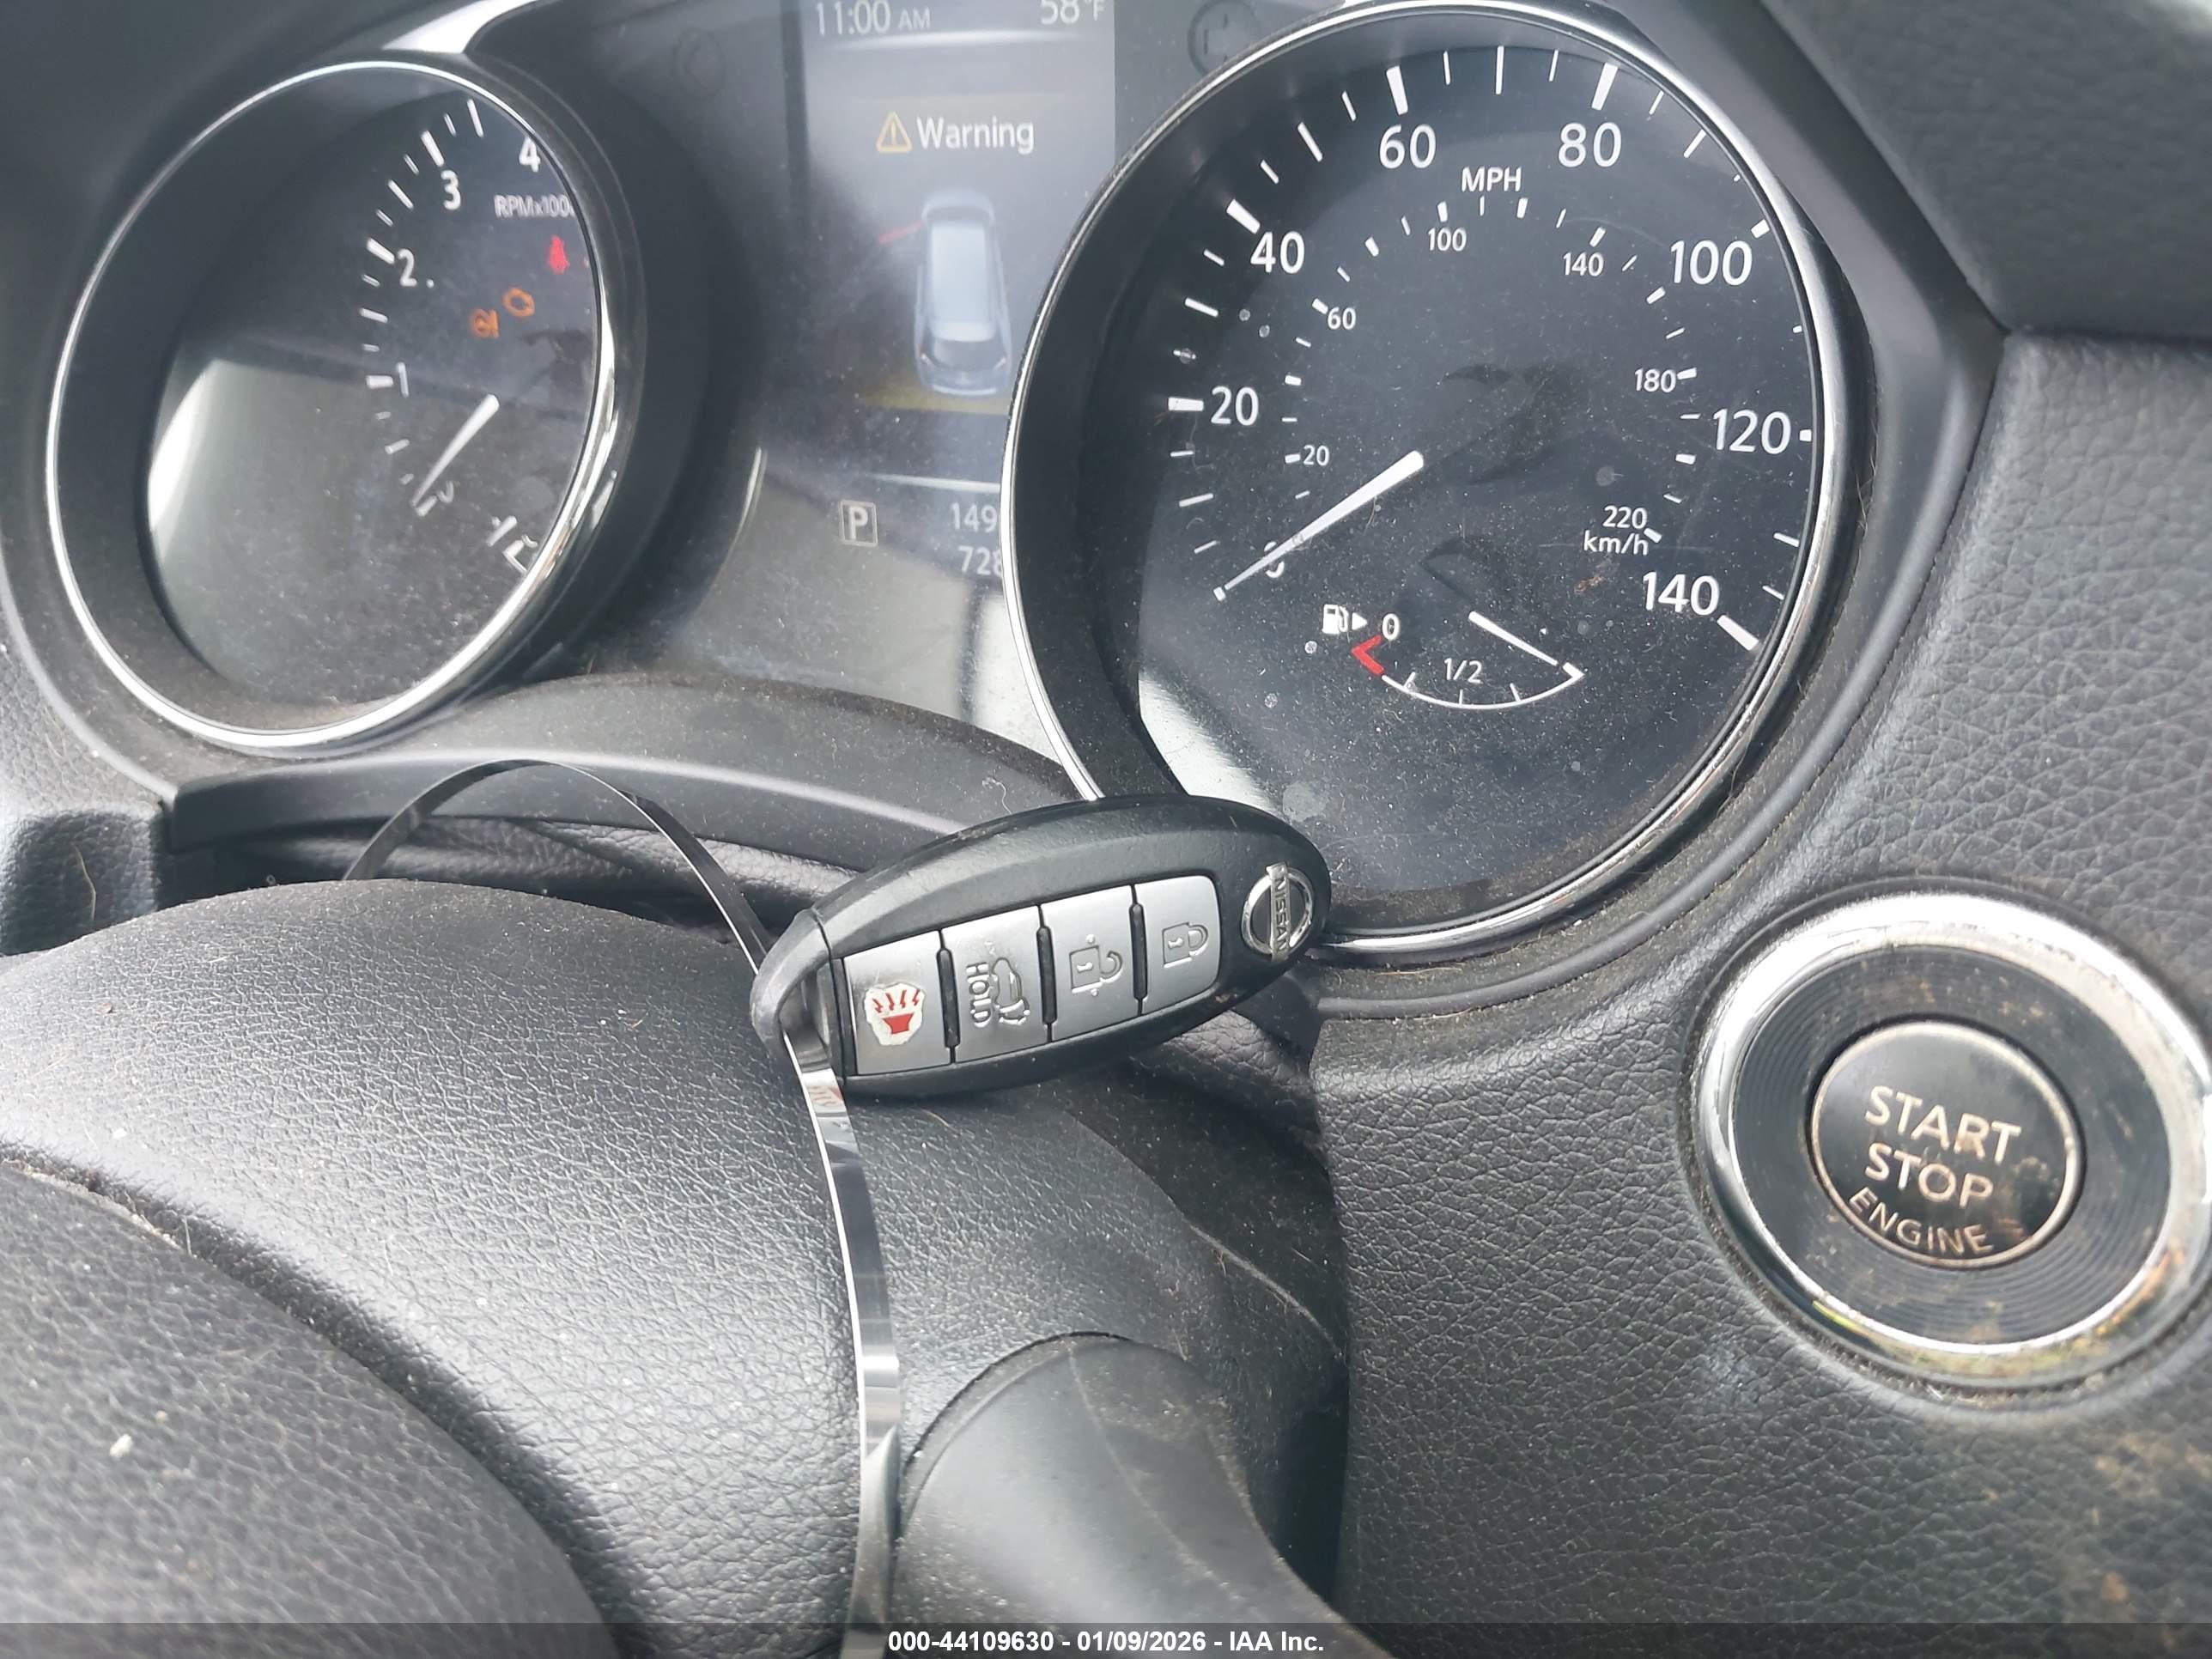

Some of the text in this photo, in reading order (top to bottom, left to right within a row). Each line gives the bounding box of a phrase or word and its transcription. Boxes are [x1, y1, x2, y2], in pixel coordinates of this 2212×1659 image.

[817, 0, 930, 35] 11:00 AM
[917, 117, 1035, 155] Warning
[1379, 125, 1436, 168] 60
[1558, 122, 1622, 168] 80
[519, 137, 541, 172] 4
[441, 171, 462, 210] 3
[1462, 167, 1522, 192] MPH
[494, 194, 577, 218] RPMx100
[1250, 231, 1305, 274] 40
[1428, 227, 1467, 252] 100
[398, 248, 417, 287] 2
[1563, 252, 1605, 276] 140
[1671, 240, 1753, 286] 100
[1328, 307, 1357, 330] 60
[396, 362, 409, 398] 1
[1635, 368, 1677, 392] 180
[1211, 386, 1260, 426] 20
[1712, 408, 1792, 455] 120
[1303, 446, 1330, 466] 20
[848, 505, 868, 541] P
[951, 502, 998, 533] 149
[1602, 505, 1648, 530] 220
[1583, 529, 1650, 556] km/h
[1642, 571, 1721, 617] 140
[1381, 612, 1401, 641] 0
[1443, 657, 1484, 684] 1/2
[1274, 878, 1288, 953] NISSAN
[965, 961, 993, 1029] HOLD
[1864, 1085, 2022, 1166] START
[1864, 1142, 1994, 1210] STOP
[1849, 1186, 1995, 1256] ENGINE
